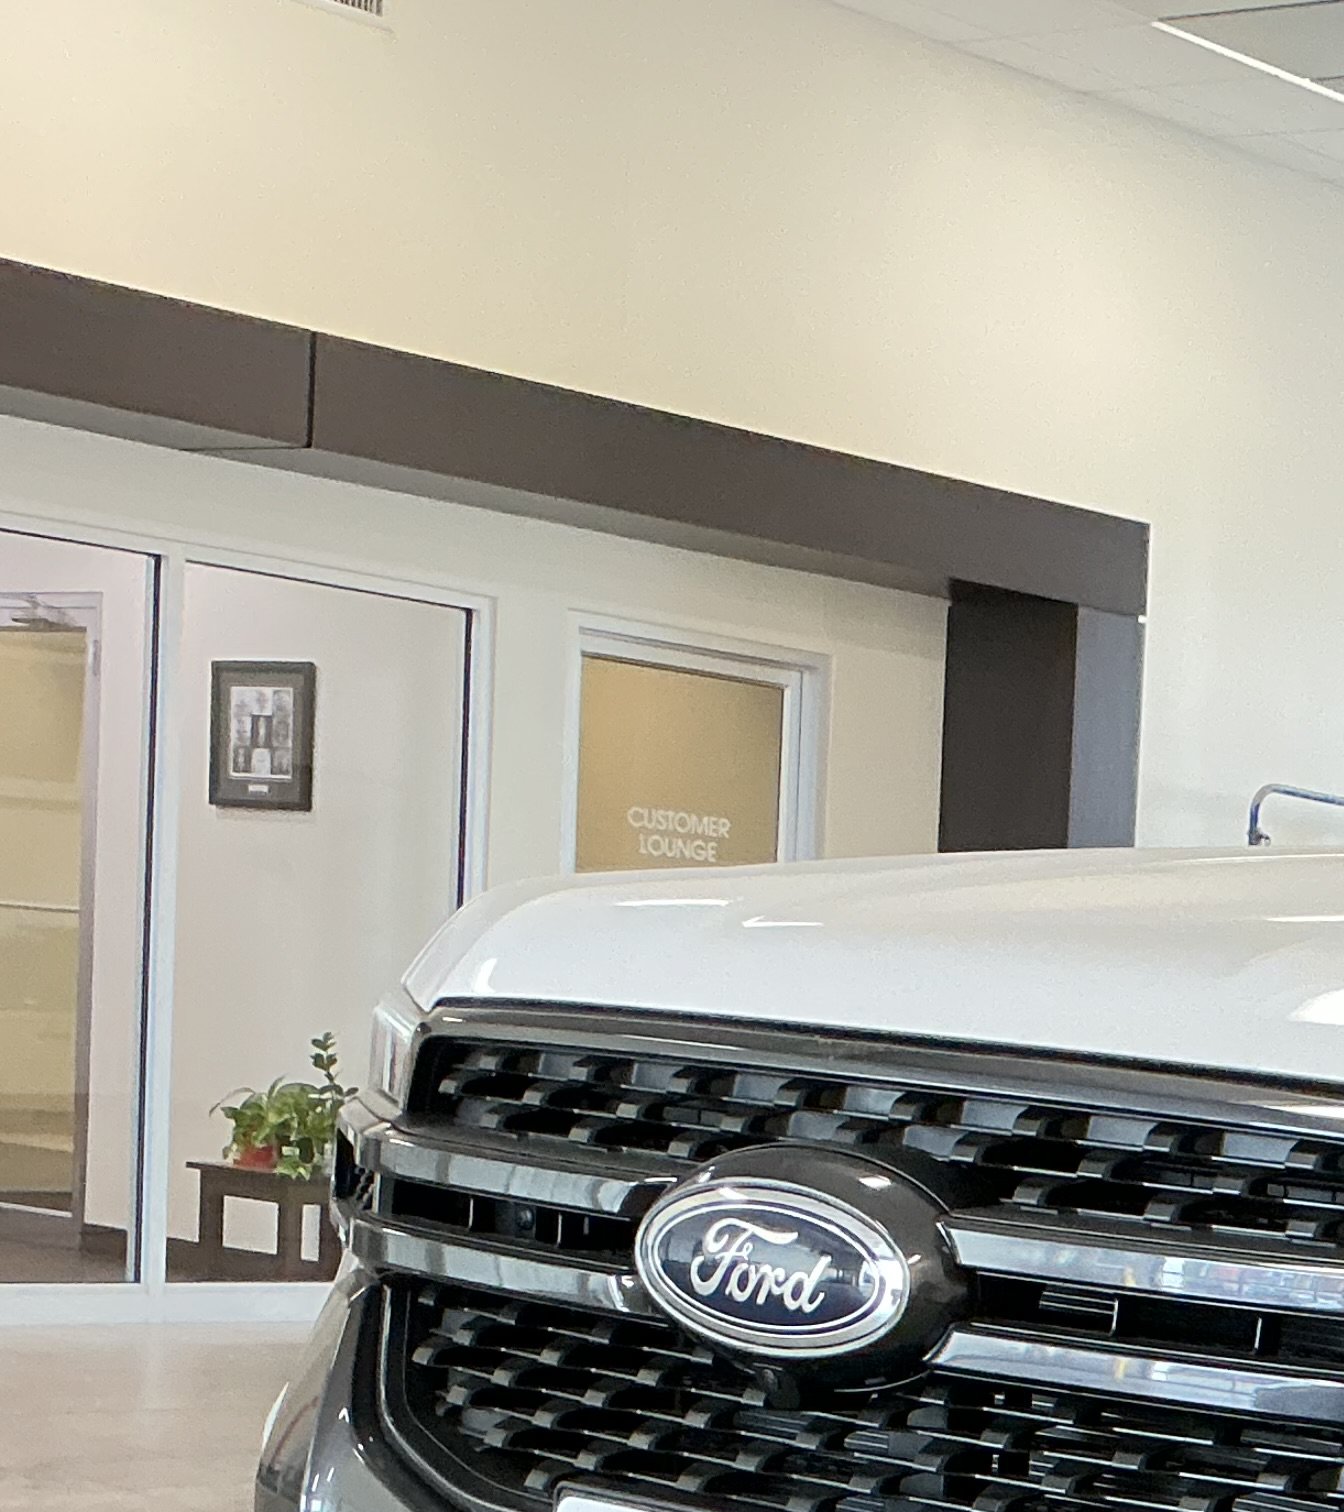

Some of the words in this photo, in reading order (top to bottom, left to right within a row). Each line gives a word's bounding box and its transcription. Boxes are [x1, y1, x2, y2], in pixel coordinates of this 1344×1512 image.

[627, 806, 731, 838] CUSTOMER
[638, 833, 718, 863] LOUNGE
[689, 1217, 832, 1313] Ford
